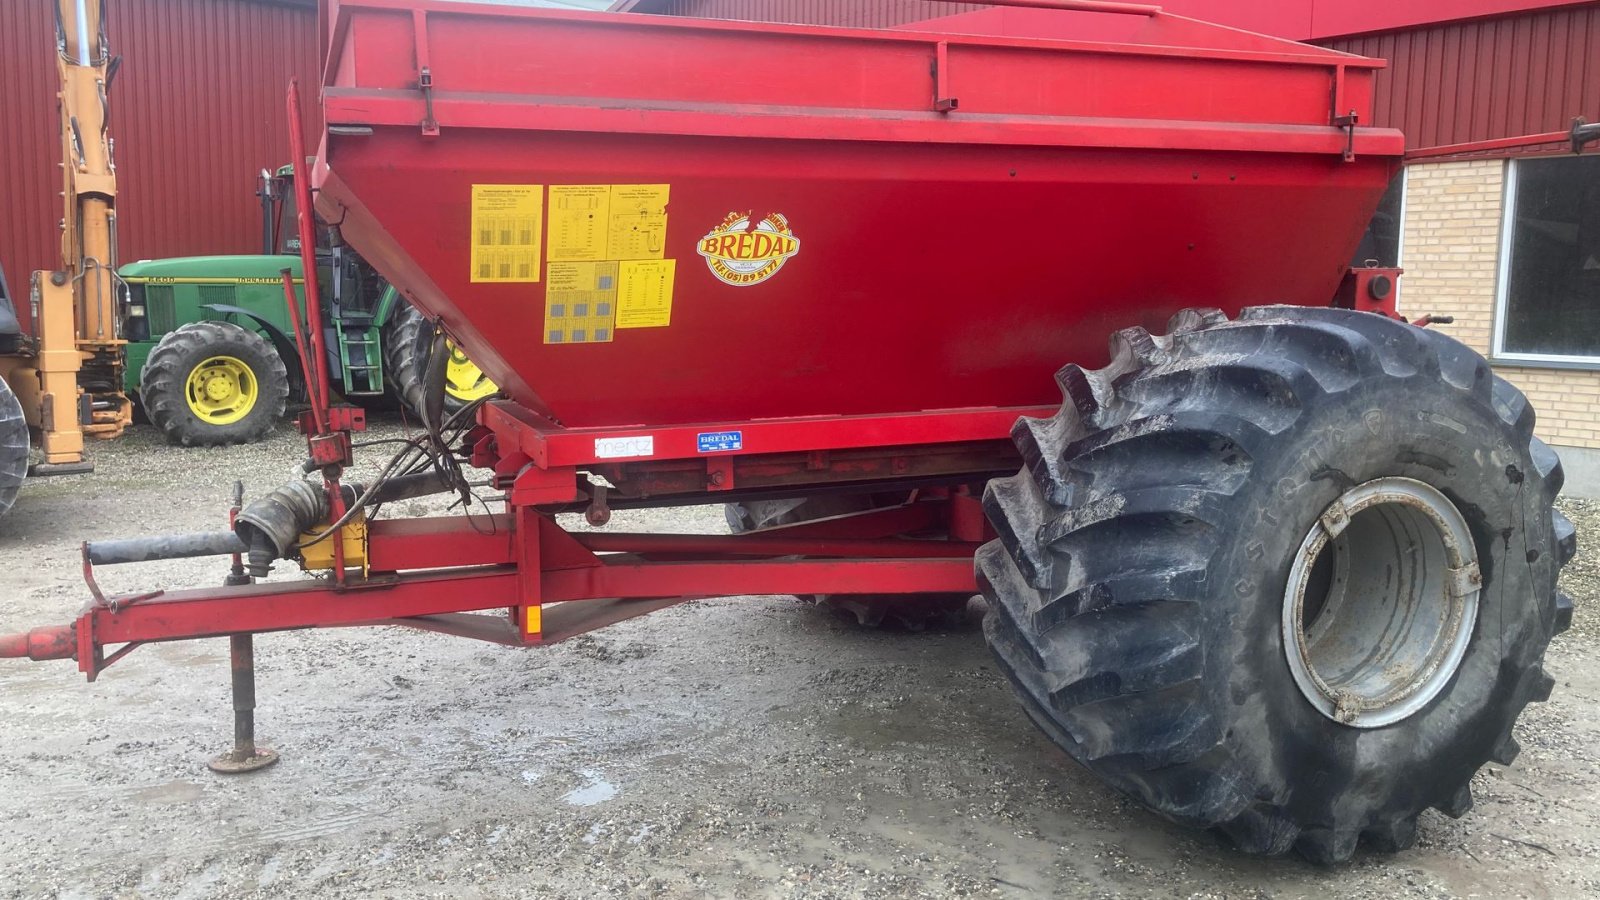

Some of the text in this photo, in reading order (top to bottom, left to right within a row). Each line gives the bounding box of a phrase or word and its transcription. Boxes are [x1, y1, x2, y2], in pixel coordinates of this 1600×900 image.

[704, 233, 794, 260] BREDAL
[743, 273, 755, 282] 89
[757, 269, 768, 278] 51
[768, 259, 777, 272] 77
[238, 277, 258, 285] JOHN
[596, 438, 651, 454] mertz
[700, 434, 739, 443] BREDAL
